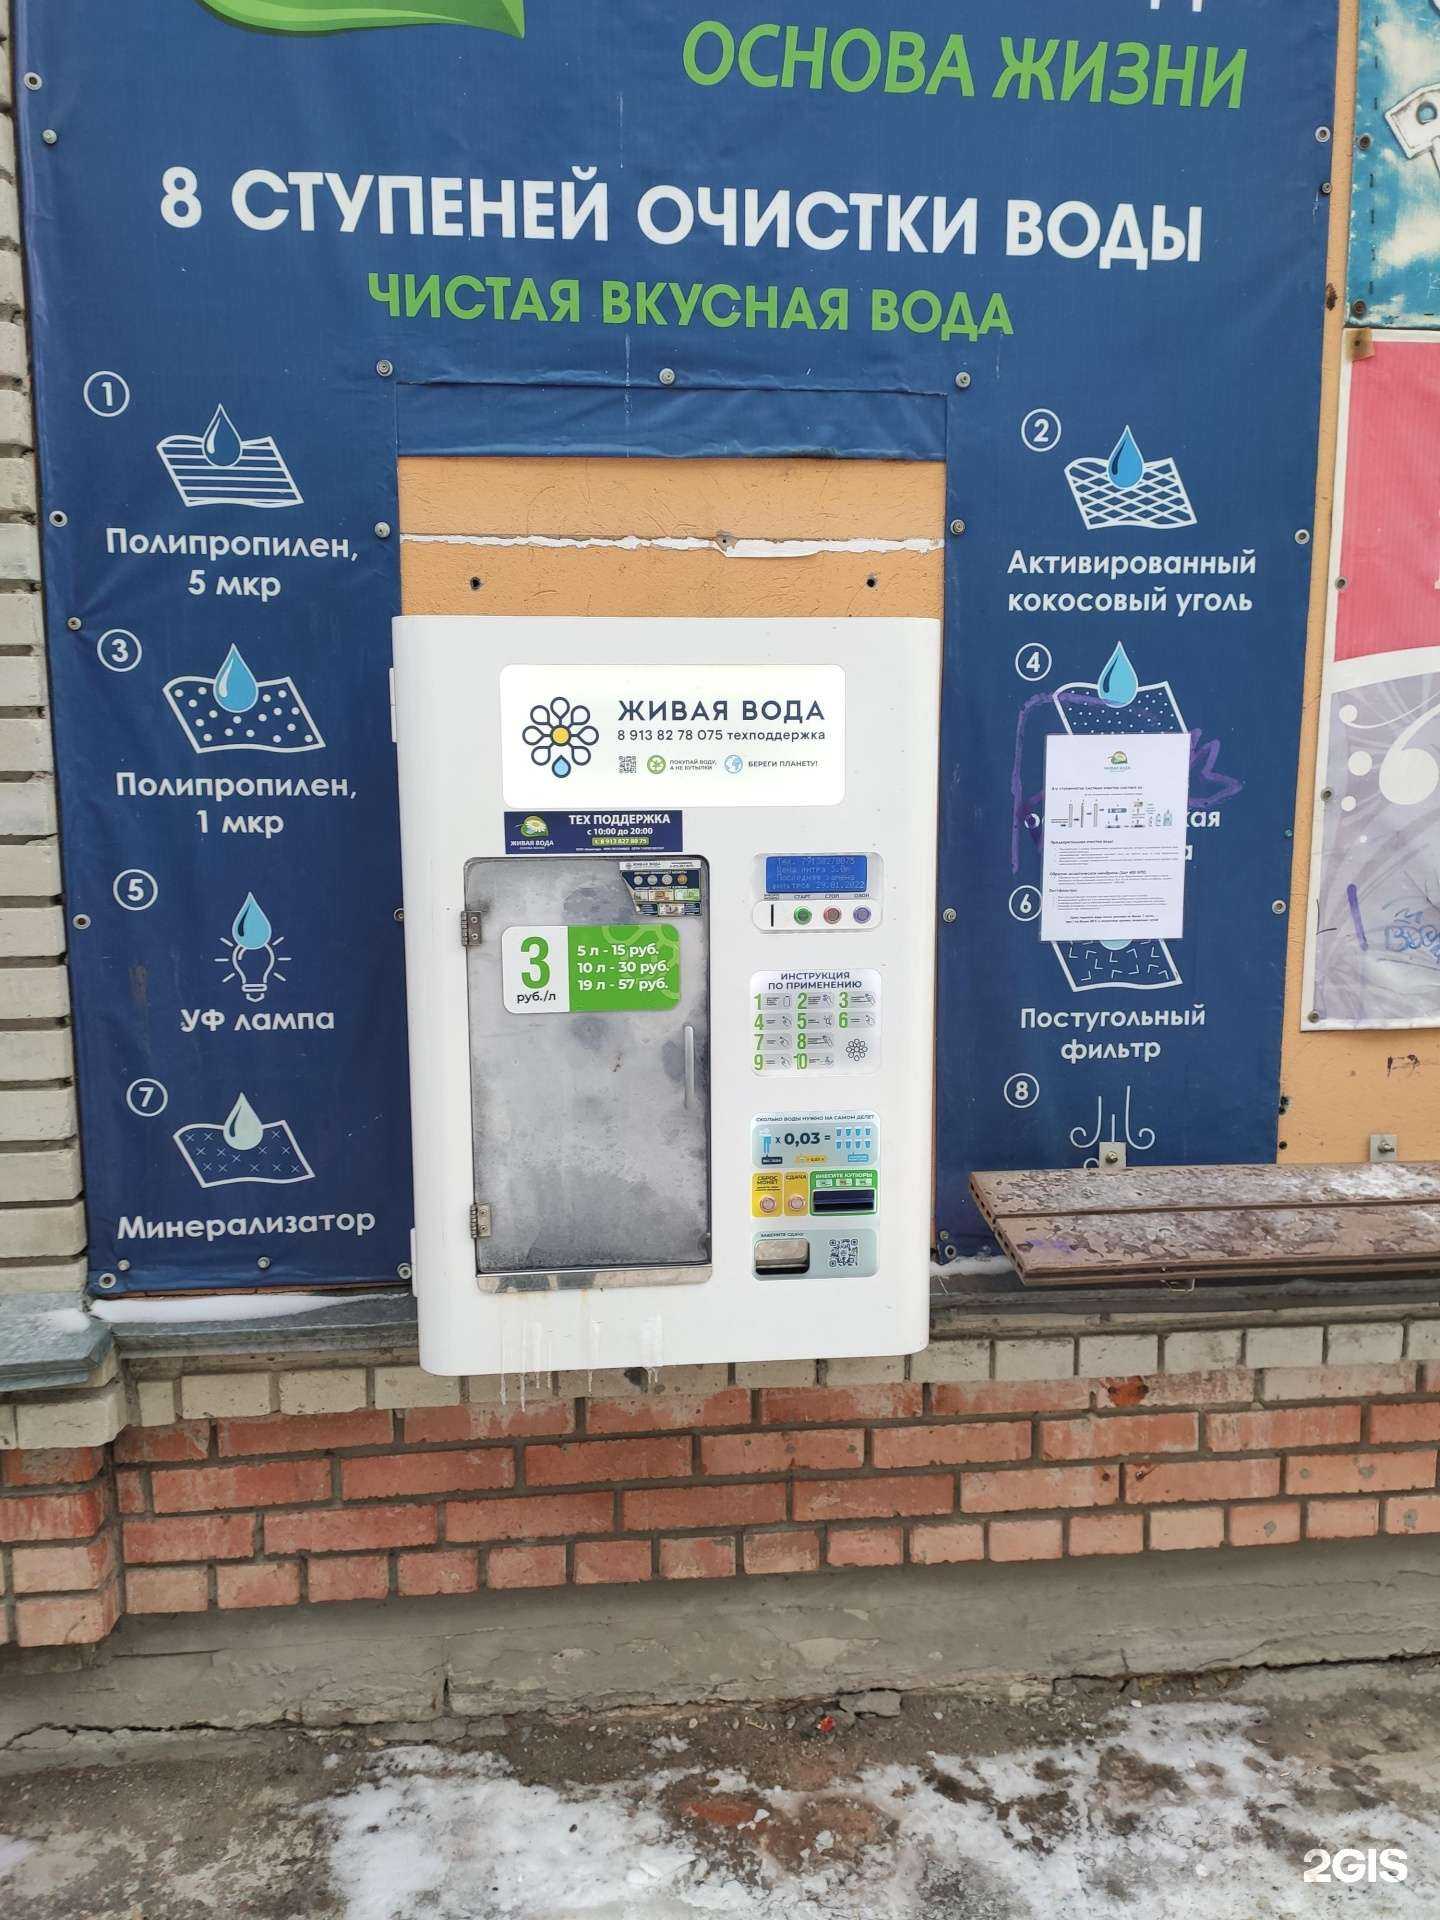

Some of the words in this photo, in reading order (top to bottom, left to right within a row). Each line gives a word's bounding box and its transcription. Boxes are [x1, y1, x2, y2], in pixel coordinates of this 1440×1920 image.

[682, 21, 974, 96] ОСНОВА
[992, 37, 1247, 109] ЖИЗНИ
[161, 167, 201, 228] 8
[232, 166, 608, 241] СТУПЕНЕЙ
[638, 185, 977, 254] ОЧИСТКИ
[1006, 200, 1202, 270] ВОДЫ
[369, 272, 581, 323] ЧИСТАЯ
[601, 280, 848, 330] ВКУСНАЯ
[872, 288, 1013, 343] ВОДА
[1033, 419, 1049, 443] 2
[107, 528, 357, 561] Полипропилен,
[1008, 549, 1255, 579] Активированный
[188, 570, 205, 594] 5
[216, 577, 280, 602] мкр
[1009, 587, 1166, 611] кокосовый
[1176, 593, 1252, 616] уголь
[112, 638, 127, 662] 3
[1026, 653, 1040, 673] 4
[618, 701, 727, 720] ЖИВАЯ
[743, 700, 824, 723] ВОДА
[618, 730, 625, 740] 8
[630, 730, 652, 741] 913
[658, 730, 672, 740] 82
[678, 730, 692, 740] 78
[698, 730, 722, 740] 075
[727, 730, 826, 744] техподдержка
[117, 772, 356, 801] Полипропилен,
[197, 810, 207, 833] 1
[222, 816, 283, 838] мкр
[568, 815, 592, 826] ТЕХ
[593, 814, 671, 827] ПОДДЕРЖКА
[594, 827, 616, 837] 10:00
[617, 828, 630, 839] до
[630, 826, 653, 837] 20:00
[128, 879, 143, 901] 5
[1020, 894, 1031, 913] 6
[578, 946, 586, 956] 5
[590, 947, 598, 956] л
[612, 945, 625, 955] 15
[629, 943, 660, 959] руб.
[521, 937, 550, 989] 3
[578, 963, 592, 973] 10
[596, 965, 605, 973] л
[618, 962, 637, 973] 30
[640, 960, 670, 975] руб.
[578, 980, 592, 990] 19
[596, 982, 605, 990] л
[619, 979, 635, 989] 57
[638, 977, 669, 993] руб.
[768, 982, 784, 990] ПО
[786, 981, 862, 990] ПРИМЕНЕНИЮ
[780, 972, 850, 981] ИНСТРУКЦИЯ
[516, 990, 556, 1004] руб./л
[754, 993, 763, 1010] 1
[797, 992, 807, 1009] 2
[839, 991, 848, 1008] 3
[181, 1009, 225, 1032] УФ
[234, 1012, 334, 1030] лампа
[754, 1013, 764, 1030] 4
[797, 1012, 807, 1029] 5
[839, 1011, 848, 1028] 6
[1021, 1004, 1205, 1032] Постугольный
[754, 1033, 764, 1050] 7
[797, 1032, 806, 1049] 8
[1061, 1039, 1160, 1064] фильтр
[754, 1053, 763, 1070] 9
[794, 1052, 807, 1069] 10
[139, 1087, 153, 1107] 7
[1015, 1081, 1028, 1100] 8
[784, 1132, 821, 1148] 0,03
[118, 1213, 375, 1241] Минерализатор
